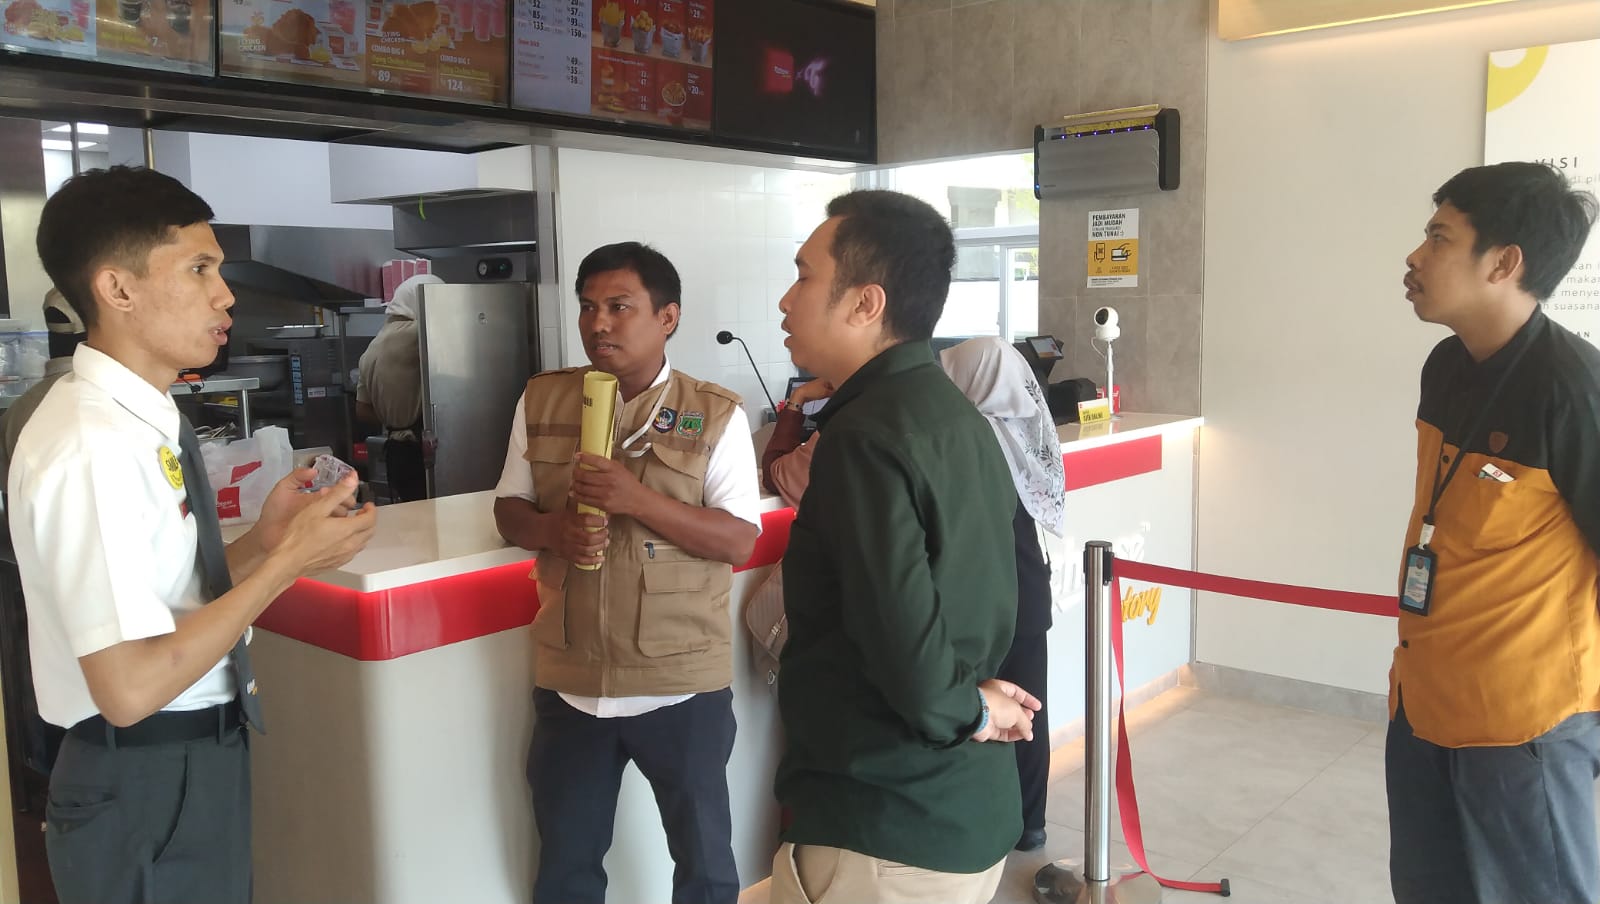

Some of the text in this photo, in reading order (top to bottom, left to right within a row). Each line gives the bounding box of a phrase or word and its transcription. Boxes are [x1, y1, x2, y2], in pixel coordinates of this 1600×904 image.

[378, 70, 391, 81] 89
[447, 79, 465, 91] 124
[1092, 213, 1126, 221] PEMBAYARAN
[1121, 585, 1162, 626] tory
